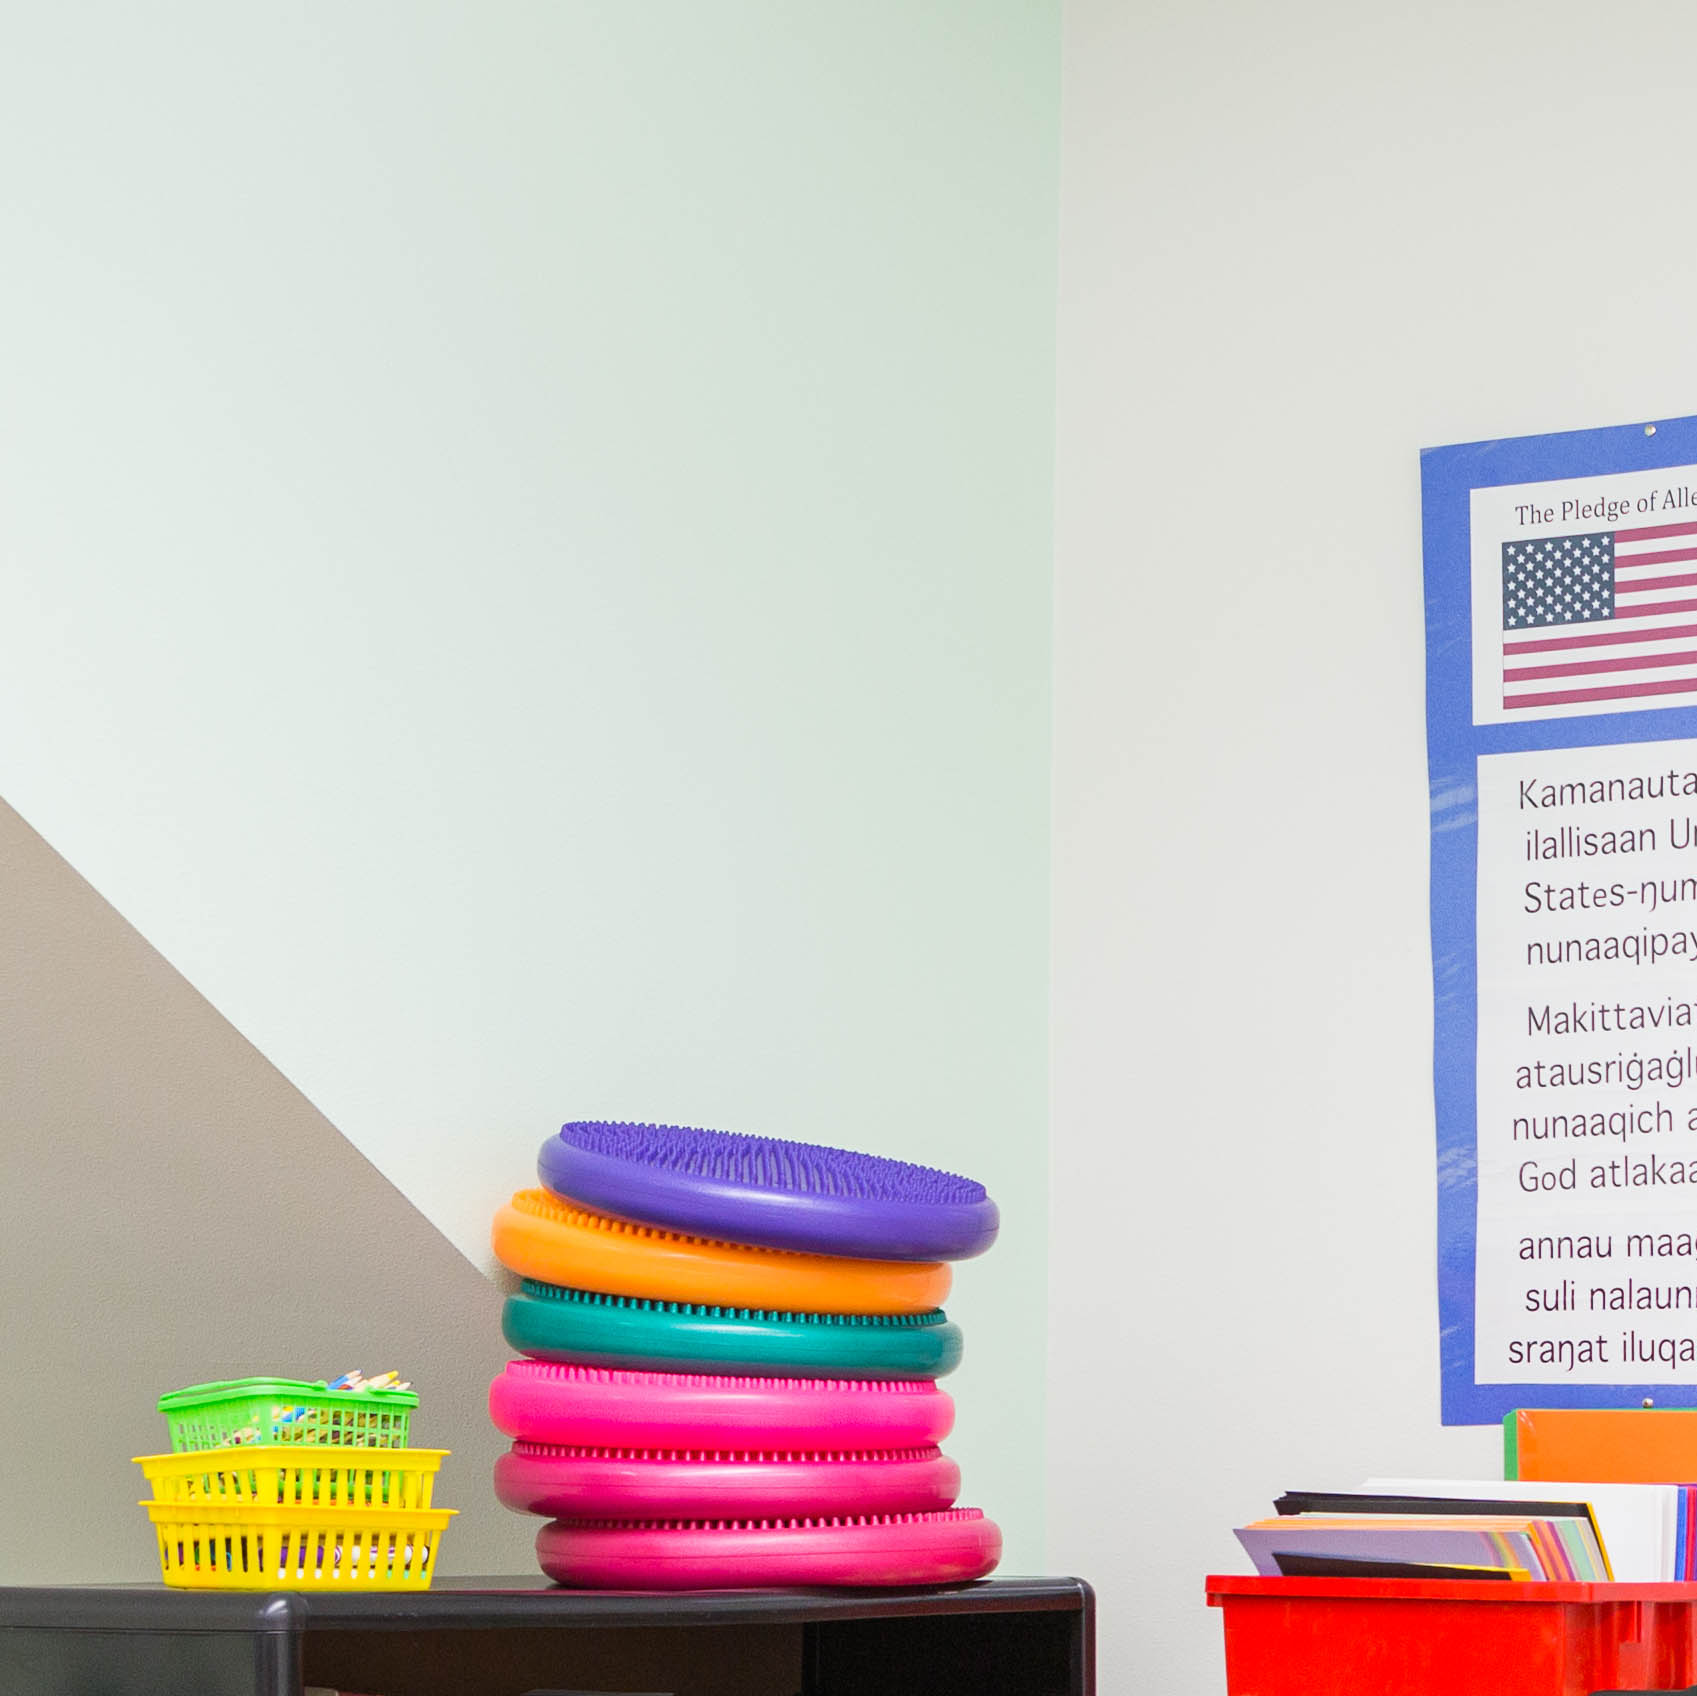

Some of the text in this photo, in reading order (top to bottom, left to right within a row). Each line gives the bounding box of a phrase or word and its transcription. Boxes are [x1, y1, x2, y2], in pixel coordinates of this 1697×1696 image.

[1514, 502, 1554, 525] The
[1561, 496, 1630, 521] Pledge
[1637, 491, 1658, 512] of
[1526, 824, 1656, 861] ilallisaan
[1512, 1101, 1672, 1142] nunaaqich
[1519, 1160, 1576, 1193] God
[1519, 1230, 1612, 1260] annau
[1525, 1279, 1575, 1312] suli
